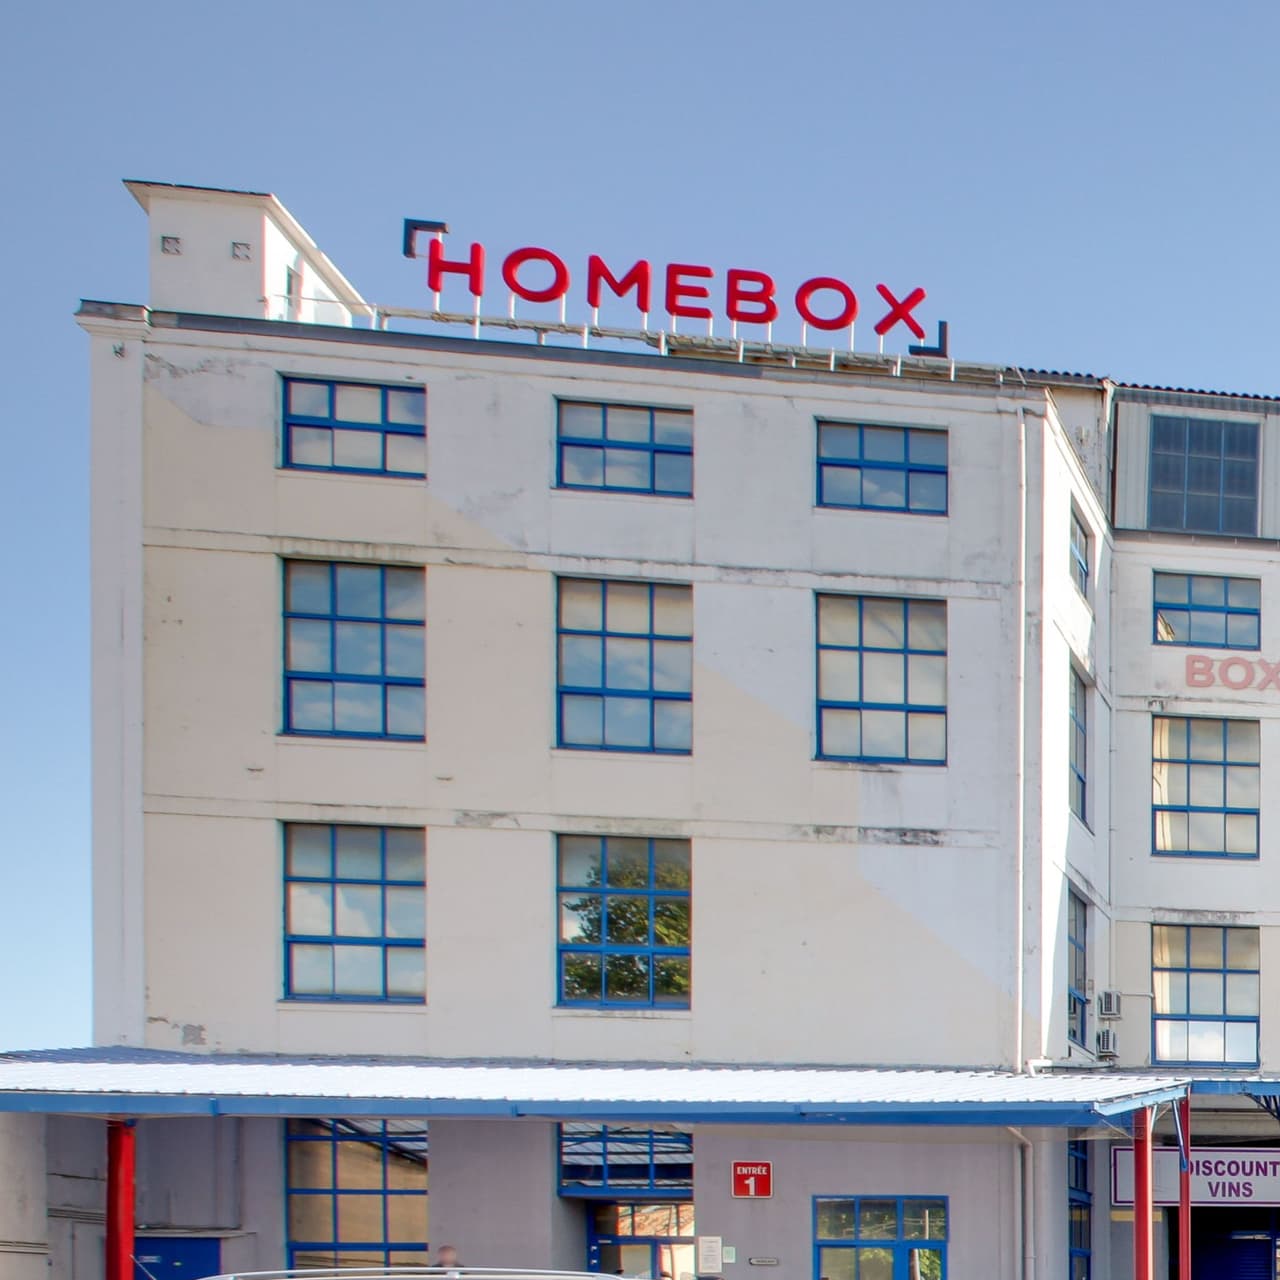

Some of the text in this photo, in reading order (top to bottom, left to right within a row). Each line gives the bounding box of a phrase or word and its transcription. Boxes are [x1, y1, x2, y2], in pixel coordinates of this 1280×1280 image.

[427, 237, 927, 341] HOMEBOX
[737, 1165, 768, 1176] ENTRÉE
[744, 1176, 757, 1196] 1
[1207, 1181, 1254, 1198] VINS
